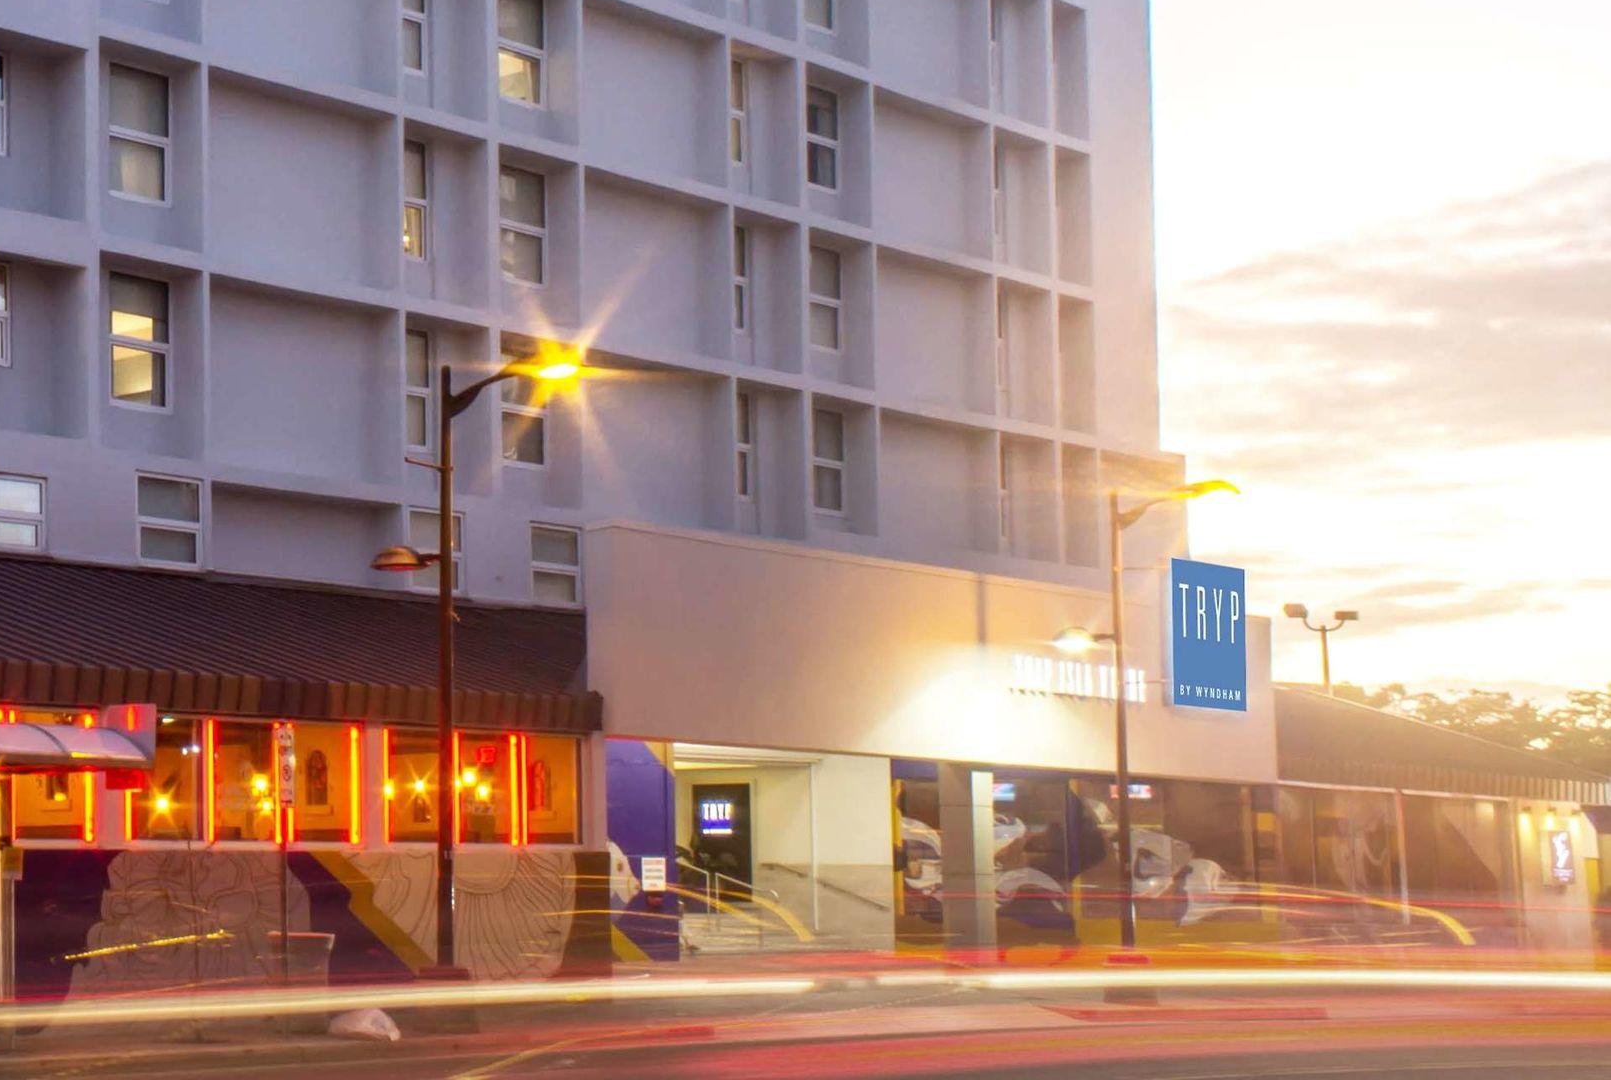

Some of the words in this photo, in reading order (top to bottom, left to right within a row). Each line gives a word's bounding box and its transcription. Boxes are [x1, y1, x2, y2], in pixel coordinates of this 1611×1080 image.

[1178, 583, 1239, 644] TRYP
[1179, 684, 1191, 696] BY
[1195, 686, 1242, 701] WYNDHAM
